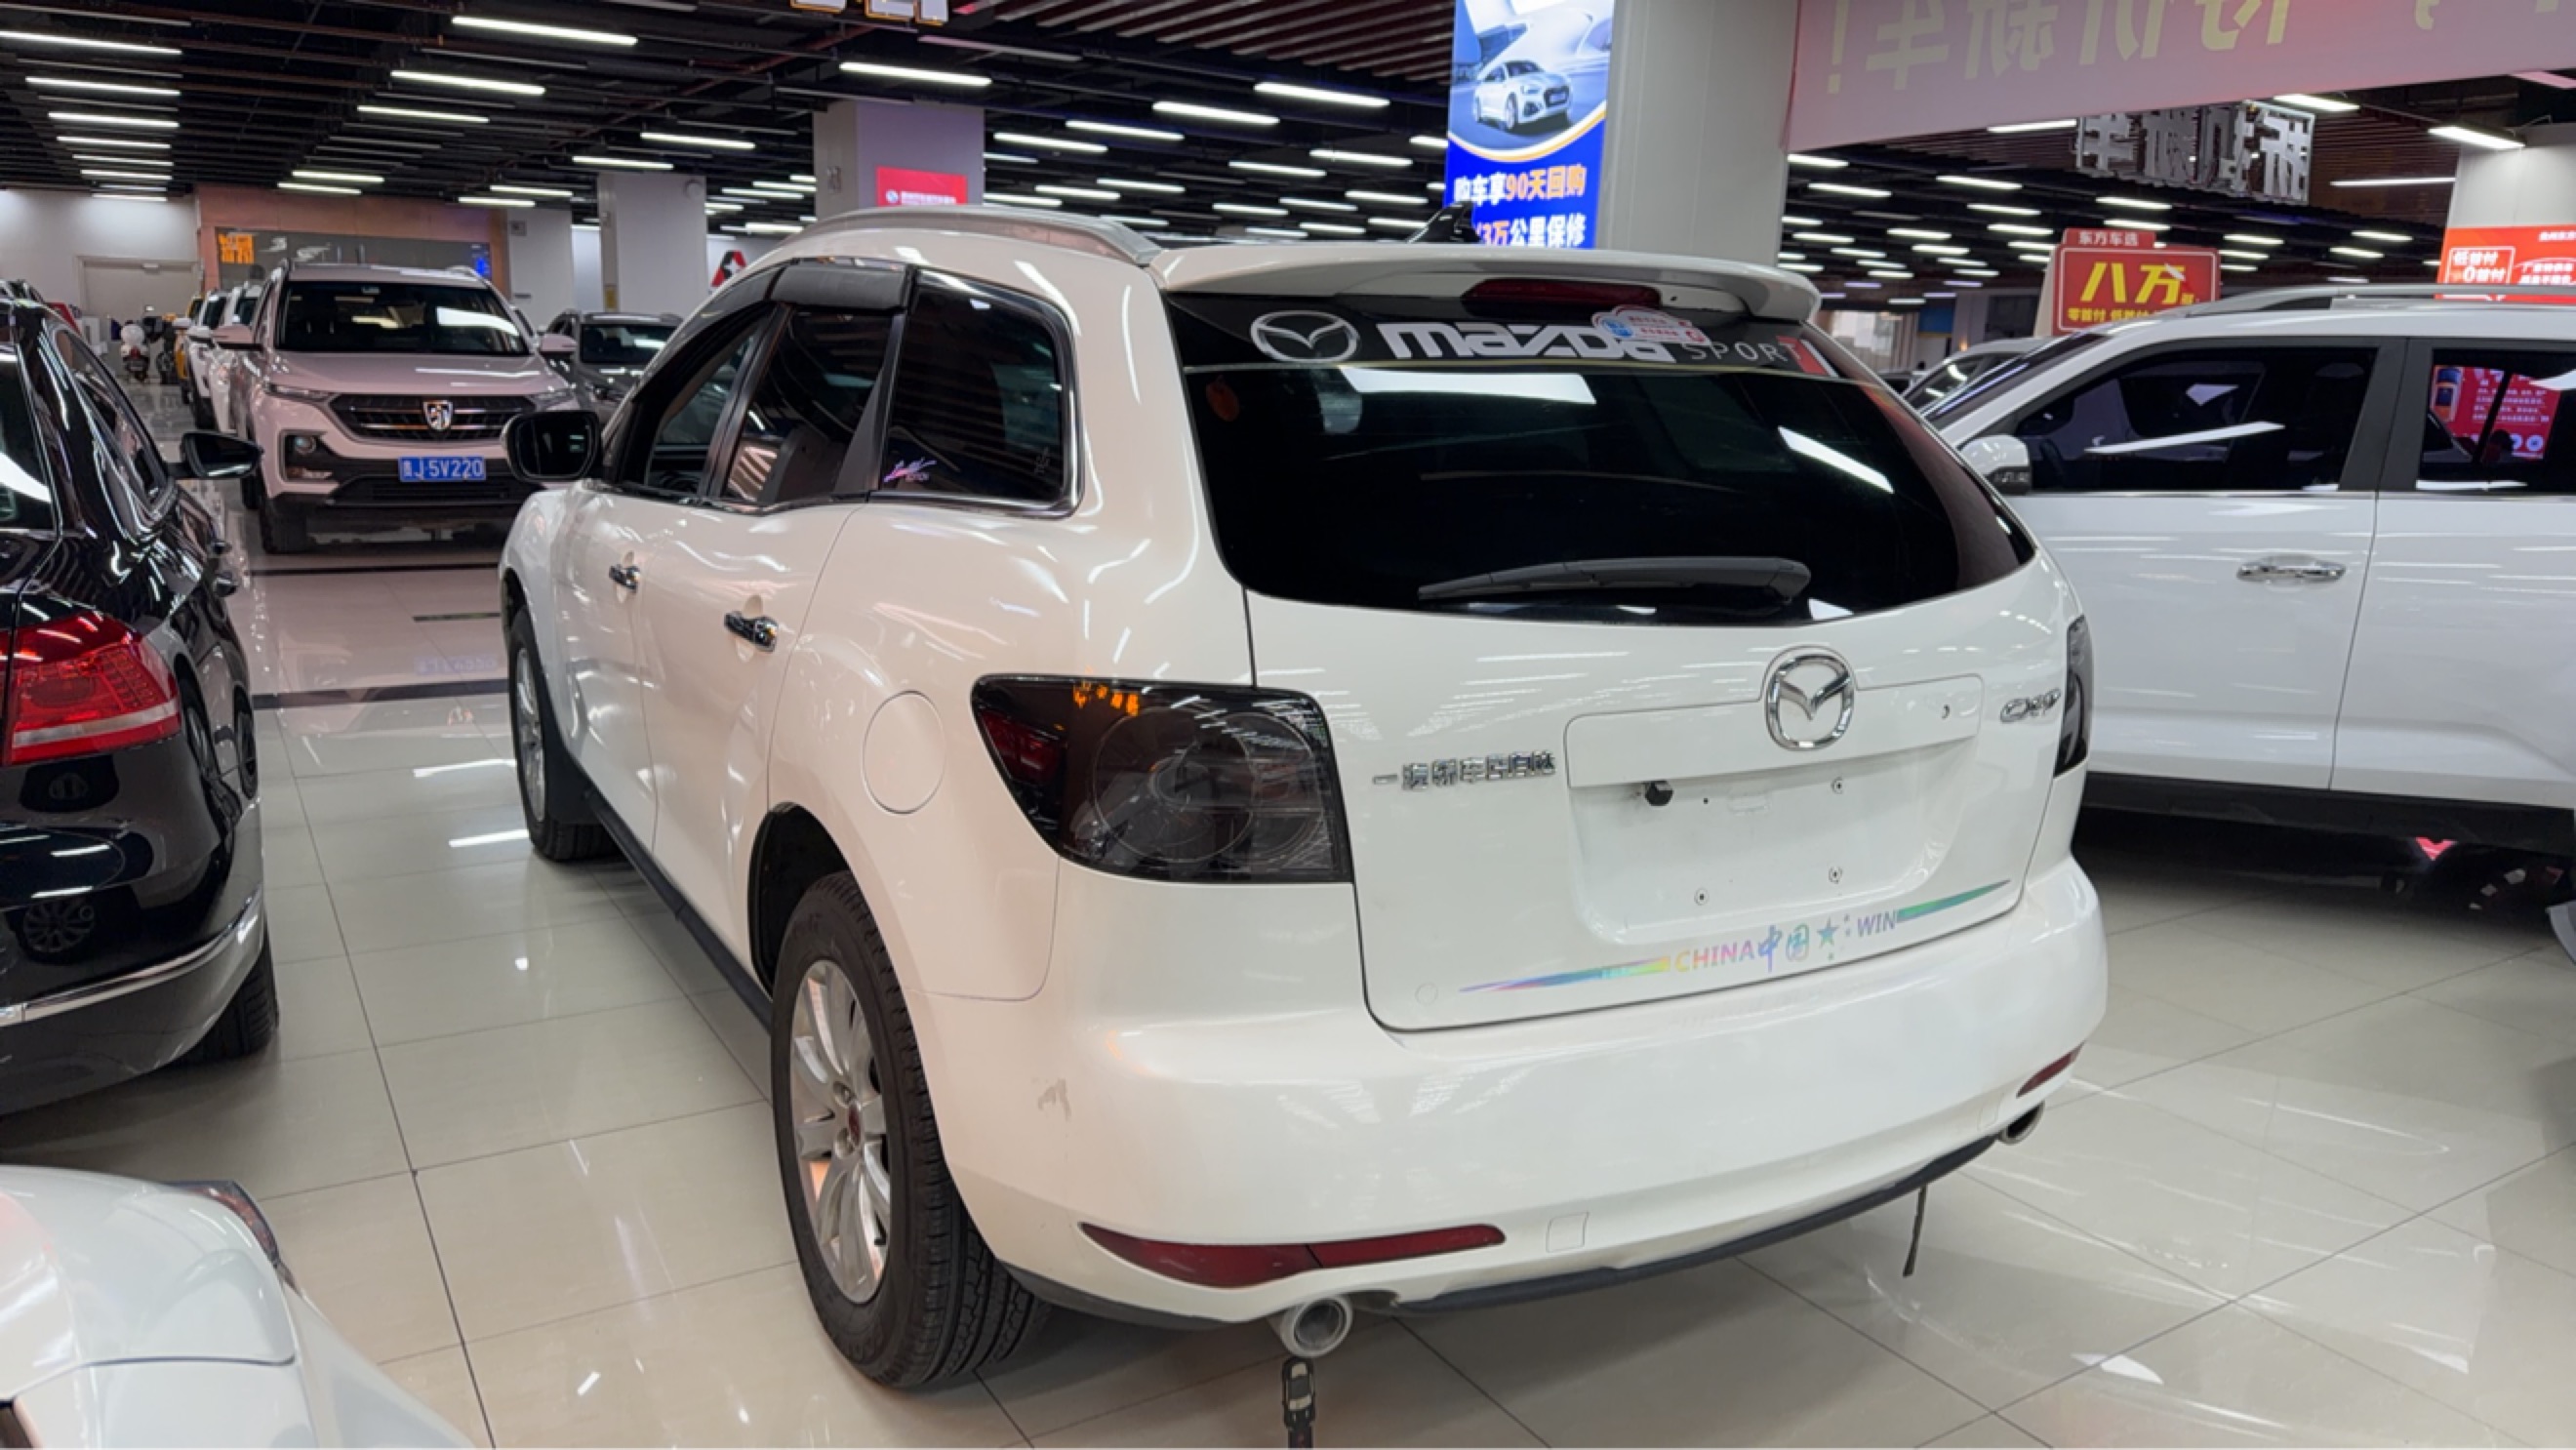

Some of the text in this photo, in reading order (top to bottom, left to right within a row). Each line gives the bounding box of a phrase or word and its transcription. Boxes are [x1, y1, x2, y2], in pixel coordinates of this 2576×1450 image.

[1454, 163, 1587, 206] 购车享90天回购
[1476, 213, 1587, 247] 3万公里保修
[1673, 909, 1898, 973] CHINA 中国 WIN
